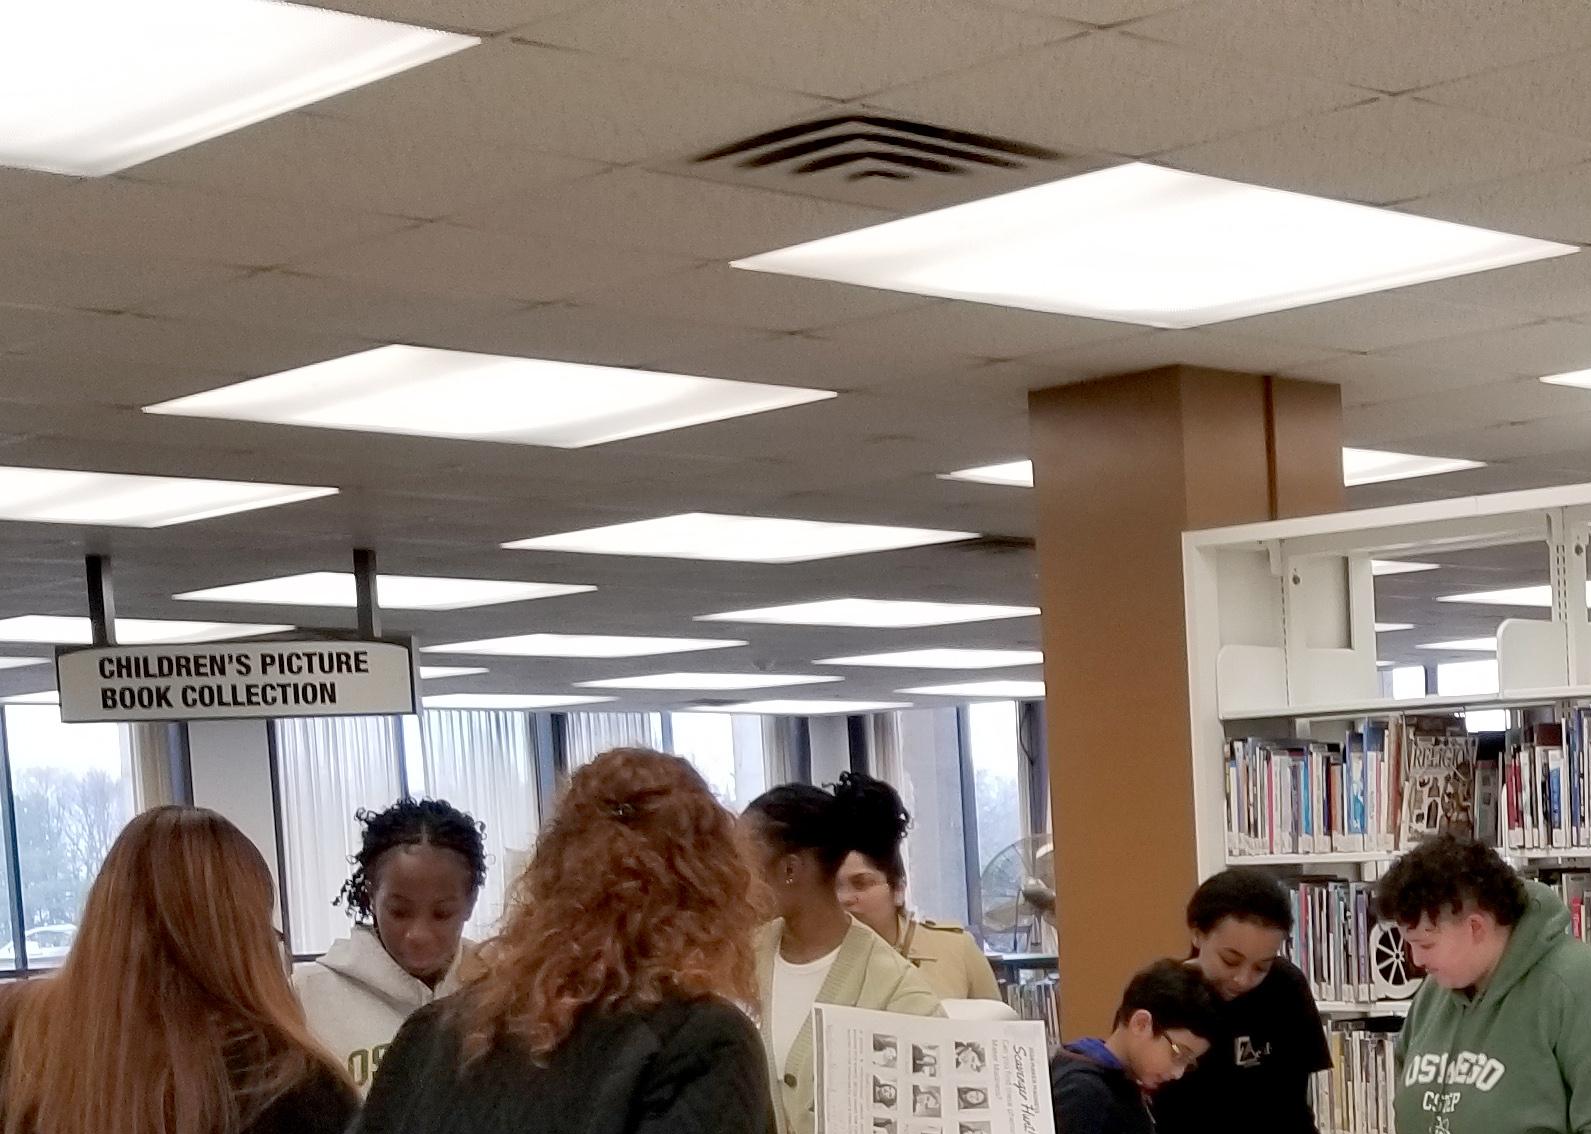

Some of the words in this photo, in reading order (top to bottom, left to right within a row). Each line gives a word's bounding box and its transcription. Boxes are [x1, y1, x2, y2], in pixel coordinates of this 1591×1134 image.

[99, 652, 251, 679] CHILDREN'S
[261, 651, 370, 677] PICTURE
[101, 685, 174, 710] BOOK
[181, 682, 337, 706] COLLECTION
[1013, 1046, 1028, 1100] Scavenger
